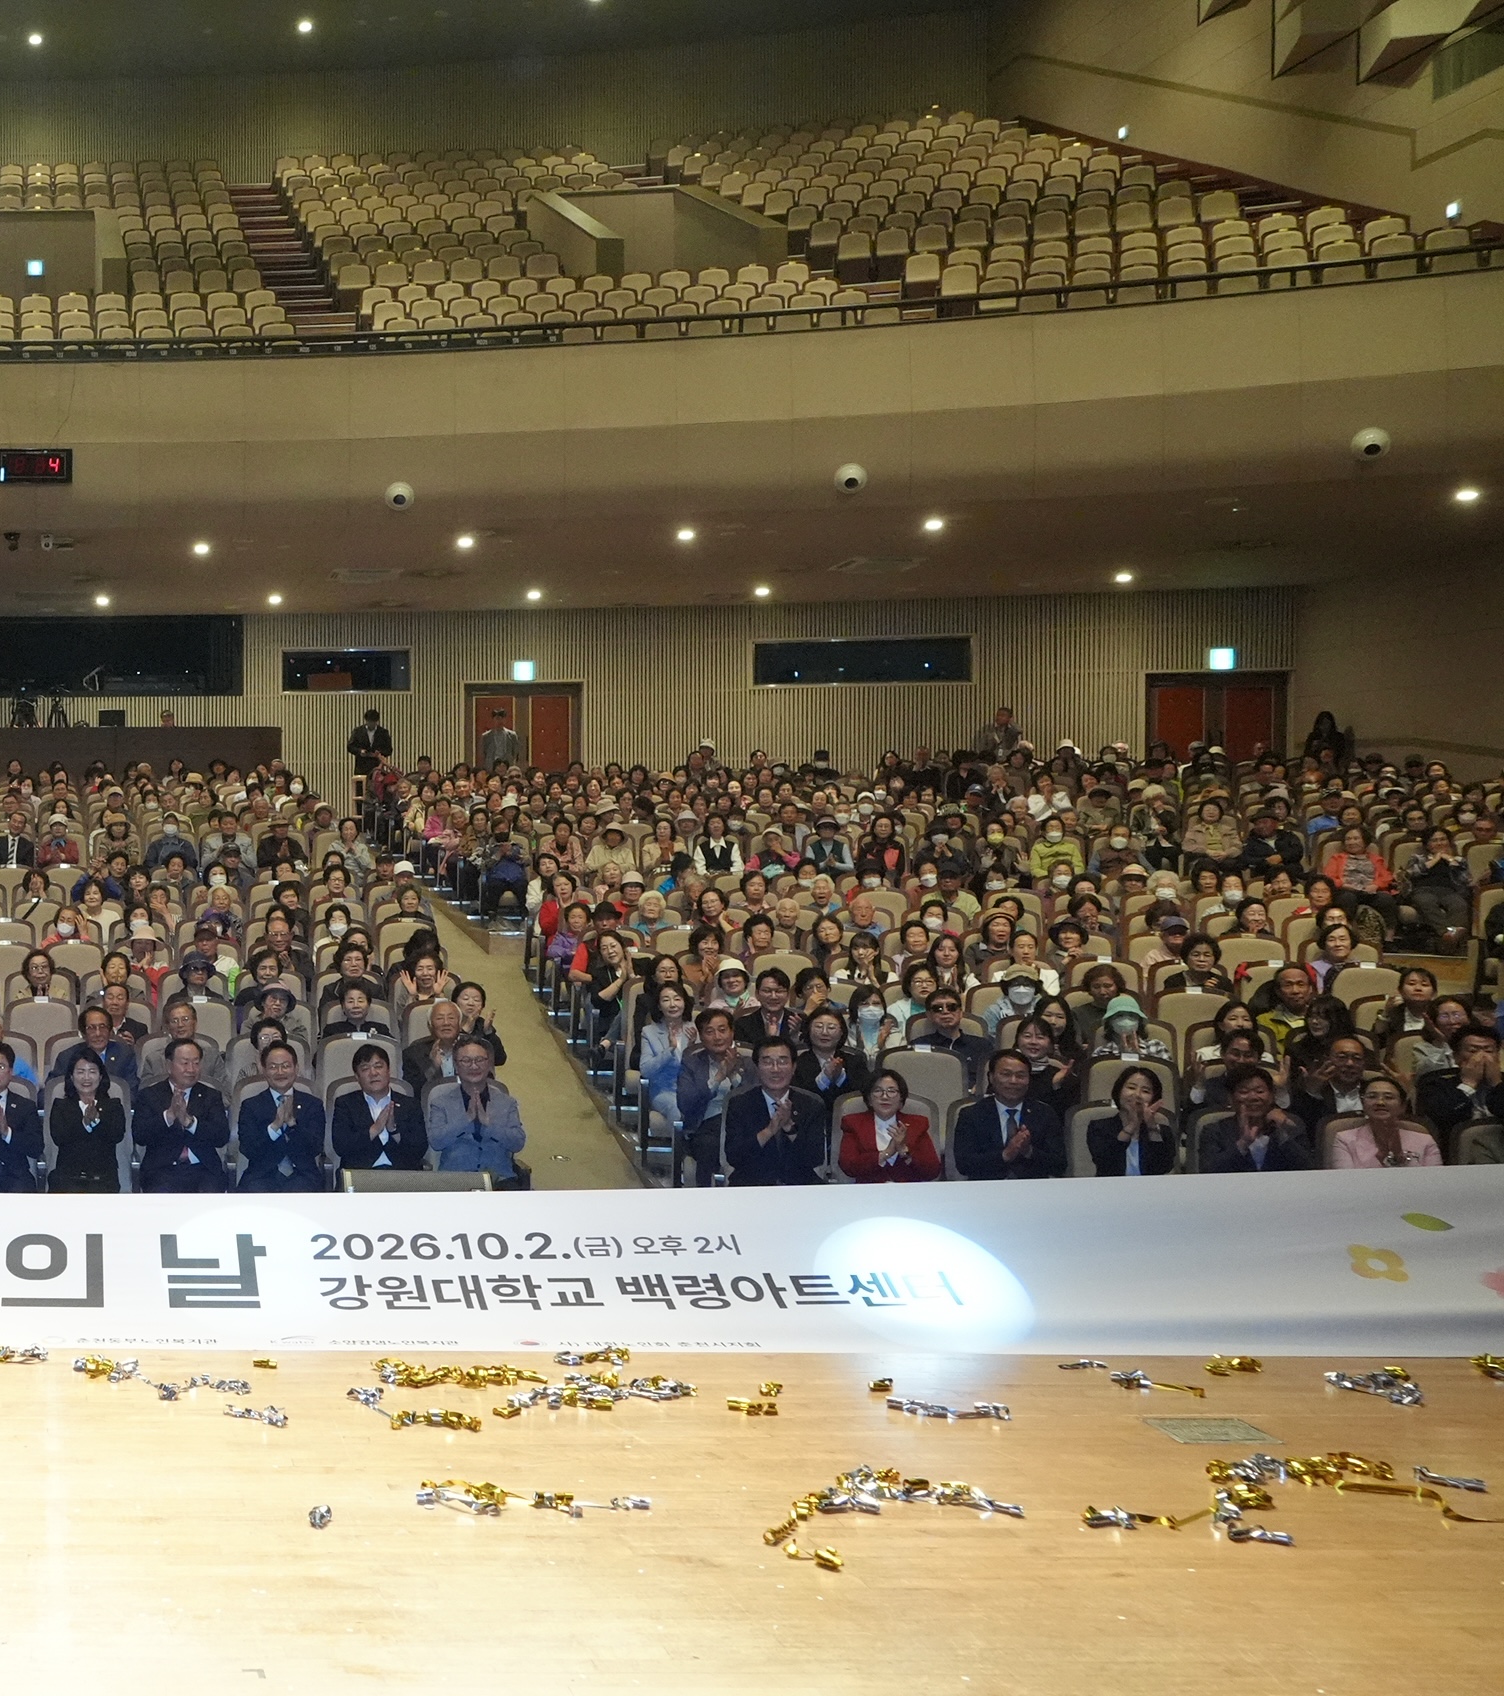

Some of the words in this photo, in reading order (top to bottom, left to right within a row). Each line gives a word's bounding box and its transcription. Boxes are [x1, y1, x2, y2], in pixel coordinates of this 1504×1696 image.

[49, 458, 60, 472] 4
[632, 1234, 688, 1257] 오후
[693, 1233, 742, 1256] 2시
[159, 1233, 268, 1309] 날
[319, 1273, 606, 1311] 강원대학교
[616, 1272, 965, 1312] 백령아트센터
